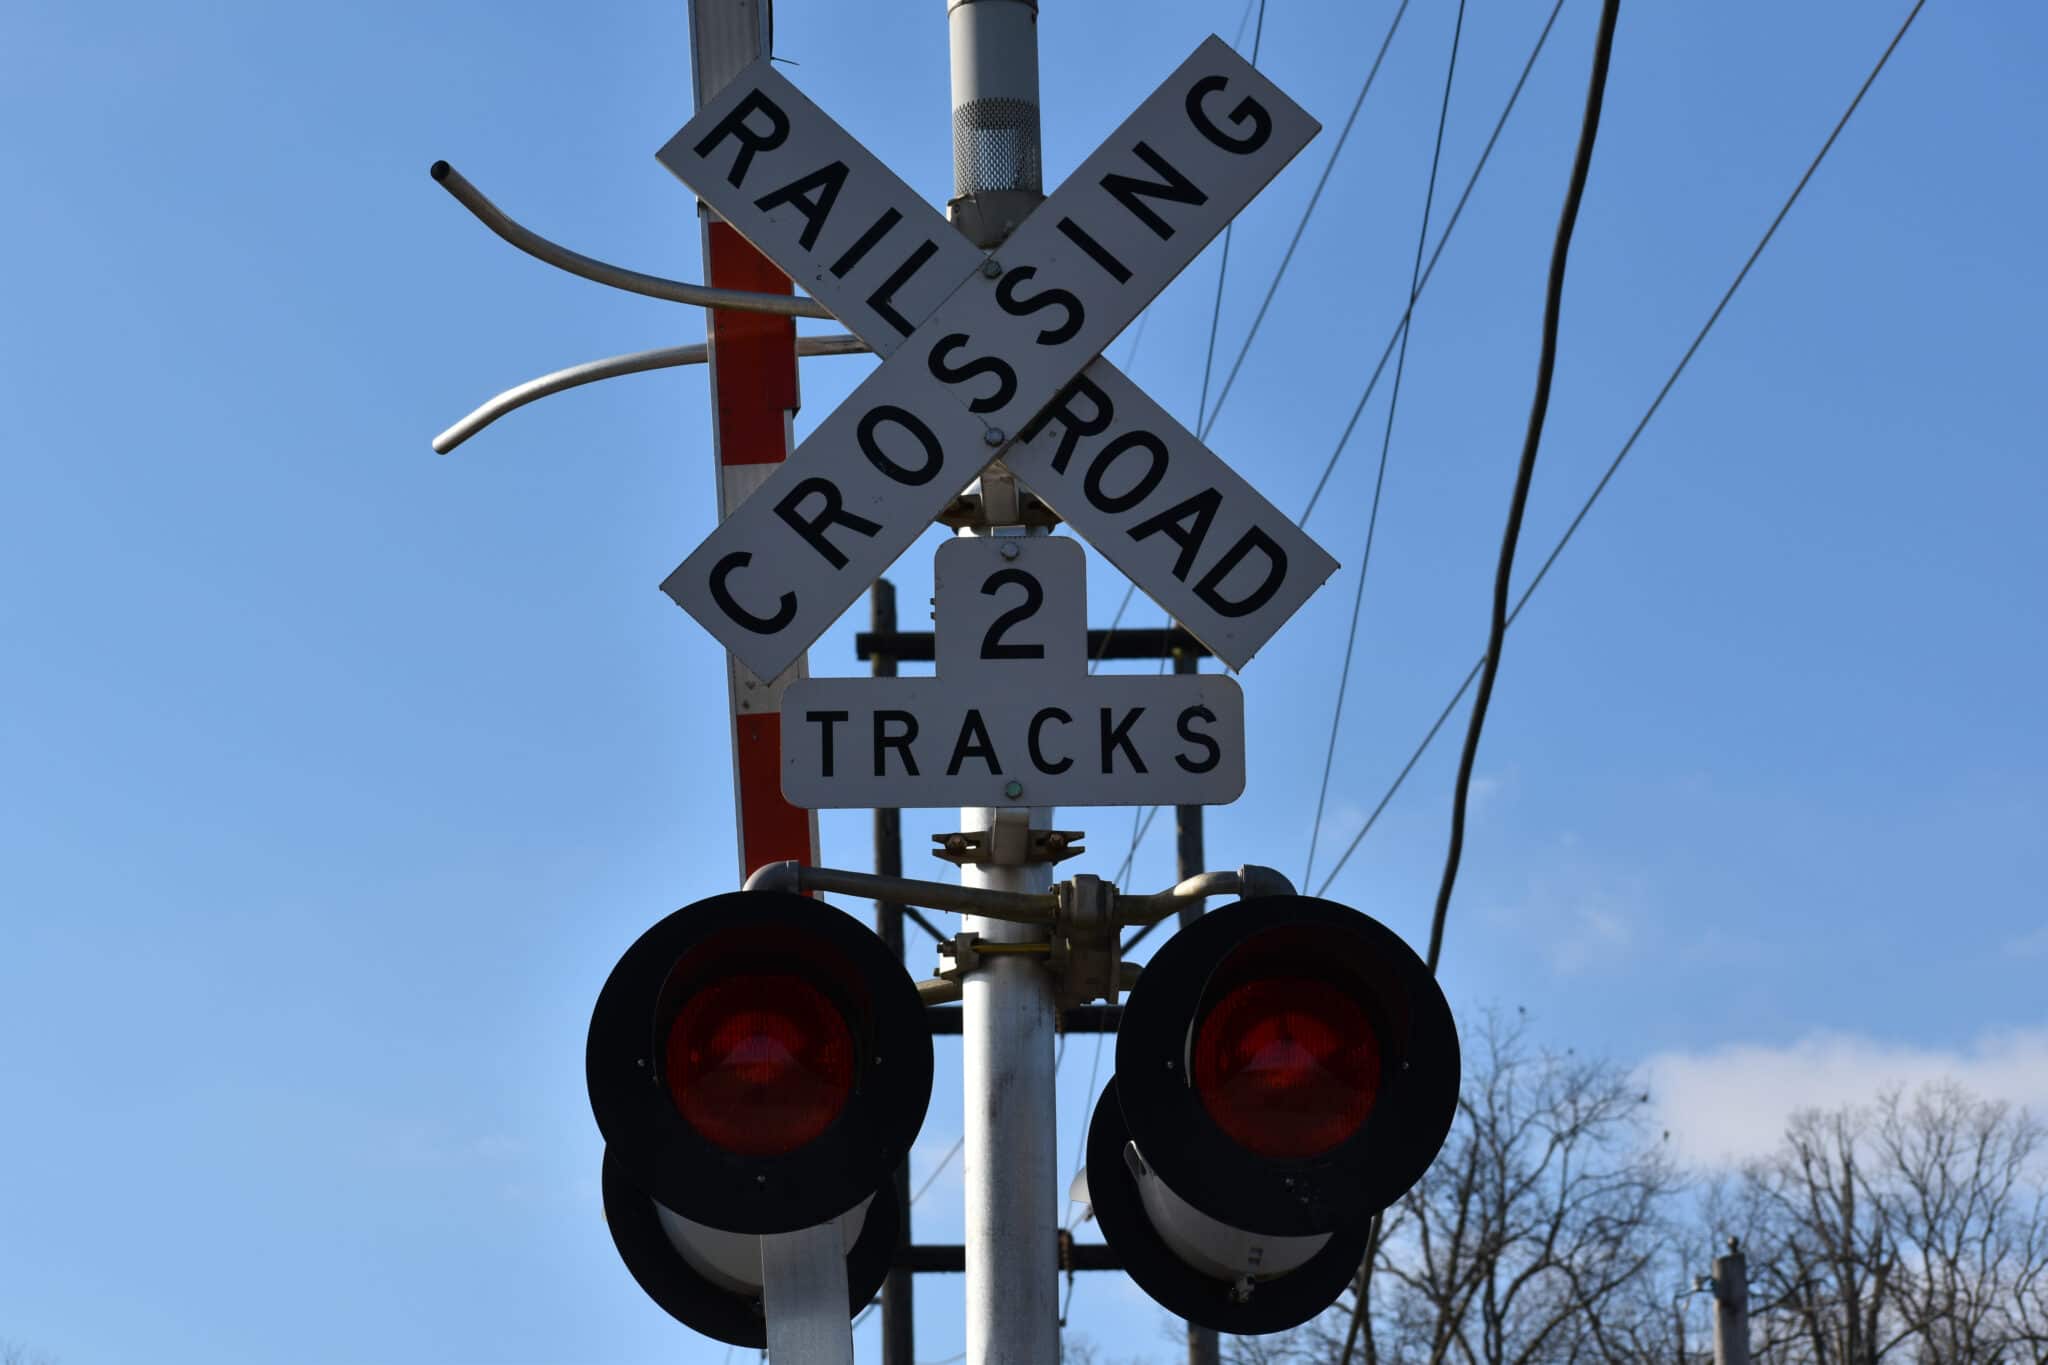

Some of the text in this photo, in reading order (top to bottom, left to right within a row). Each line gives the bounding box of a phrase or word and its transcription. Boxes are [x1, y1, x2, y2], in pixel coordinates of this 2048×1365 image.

[693, 87, 1288, 618] RAIL ROAD
[708, 75, 1273, 635] CROSSING
[805, 706, 1221, 777] TRACKS
[979, 568, 1045, 660] 2
